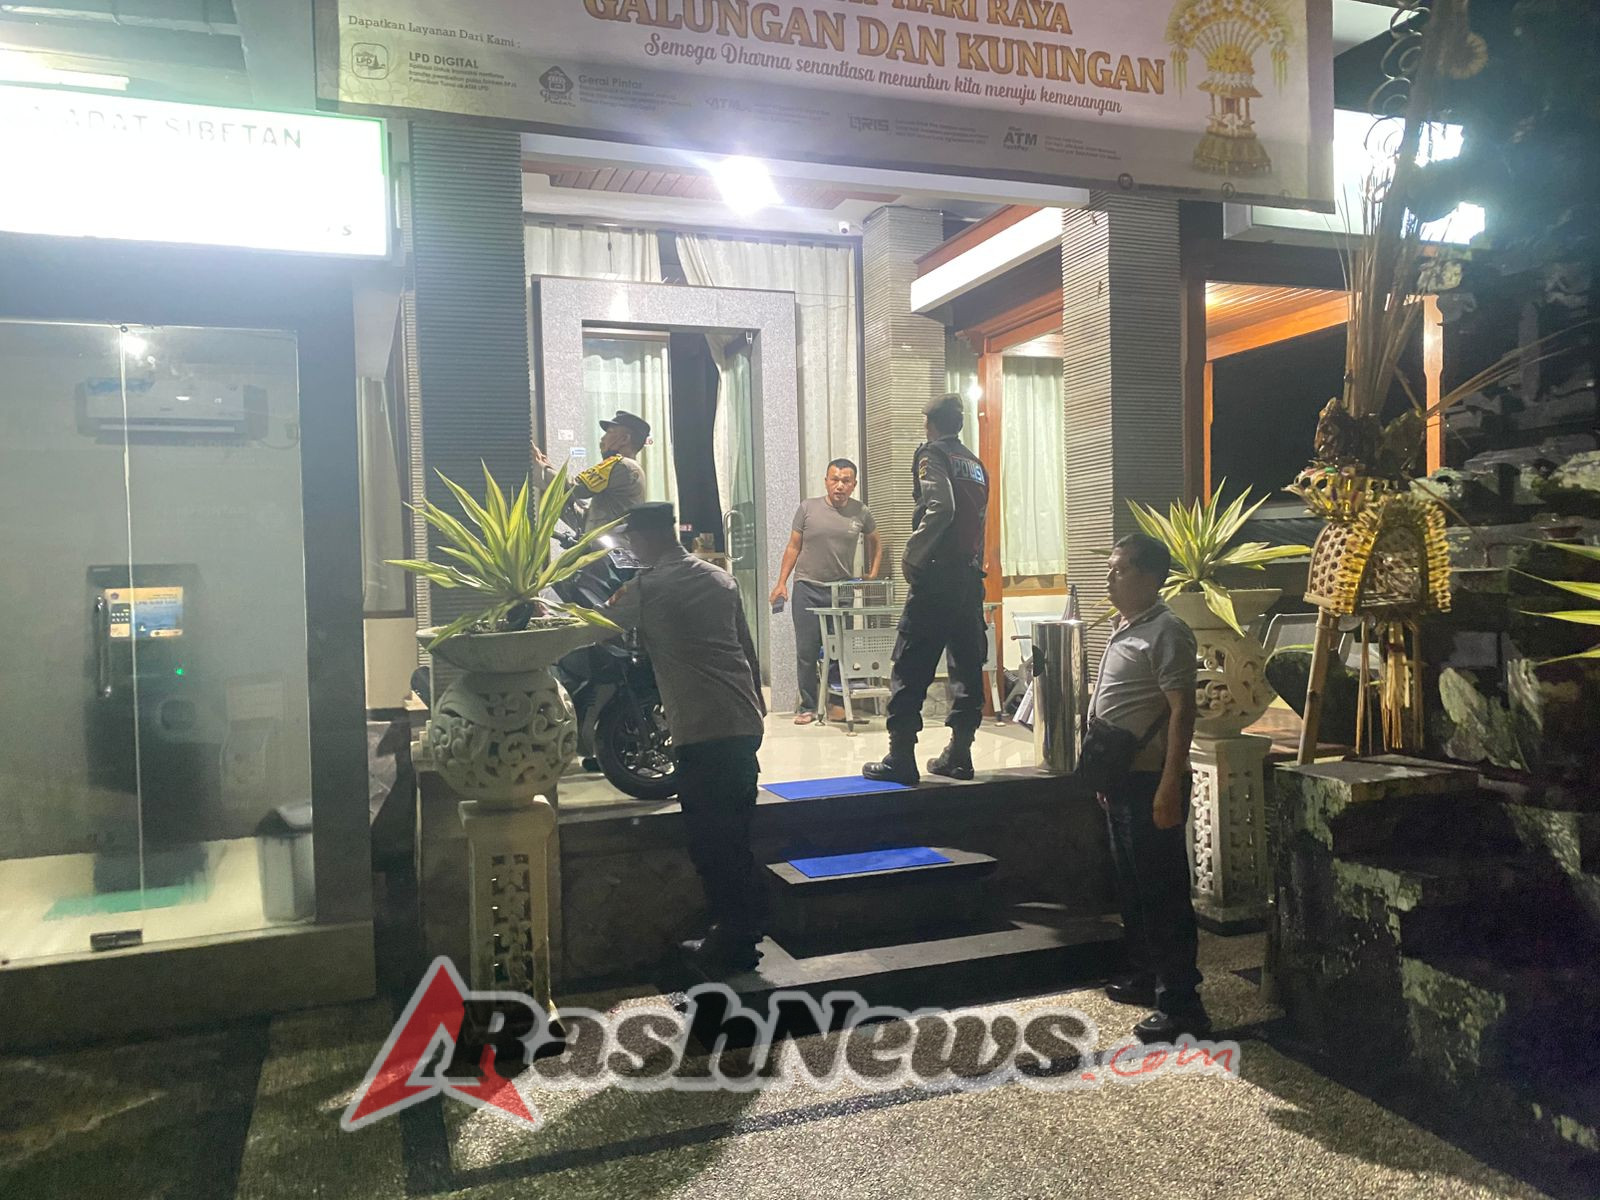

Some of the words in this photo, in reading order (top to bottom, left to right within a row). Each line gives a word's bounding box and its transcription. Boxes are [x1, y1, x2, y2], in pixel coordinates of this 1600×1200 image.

[348, 15, 406, 29] Dapatkan
[408, 22, 456, 37] Layanan
[459, 29, 484, 42] Dari
[487, 34, 515, 47] Kami
[986, 0, 1073, 35] RAYA
[408, 51, 430, 63] LPD
[433, 55, 479, 69] DIGITAL
[583, 0, 846, 51] GALUNGAN
[856, 15, 946, 67] DAN
[956, 32, 1165, 95] KUNINGAN
[644, 33, 717, 65] Semoga
[721, 43, 792, 70] Dharma
[796, 57, 876, 82] senantiasa
[878, 71, 951, 91] menuntun
[954, 76, 982, 95] kita
[985, 83, 1036, 105] menuju
[1040, 88, 1122, 115] kemenangan
[164, 116, 302, 150] SIBETAN
[1003, 132, 1038, 146] ATM
